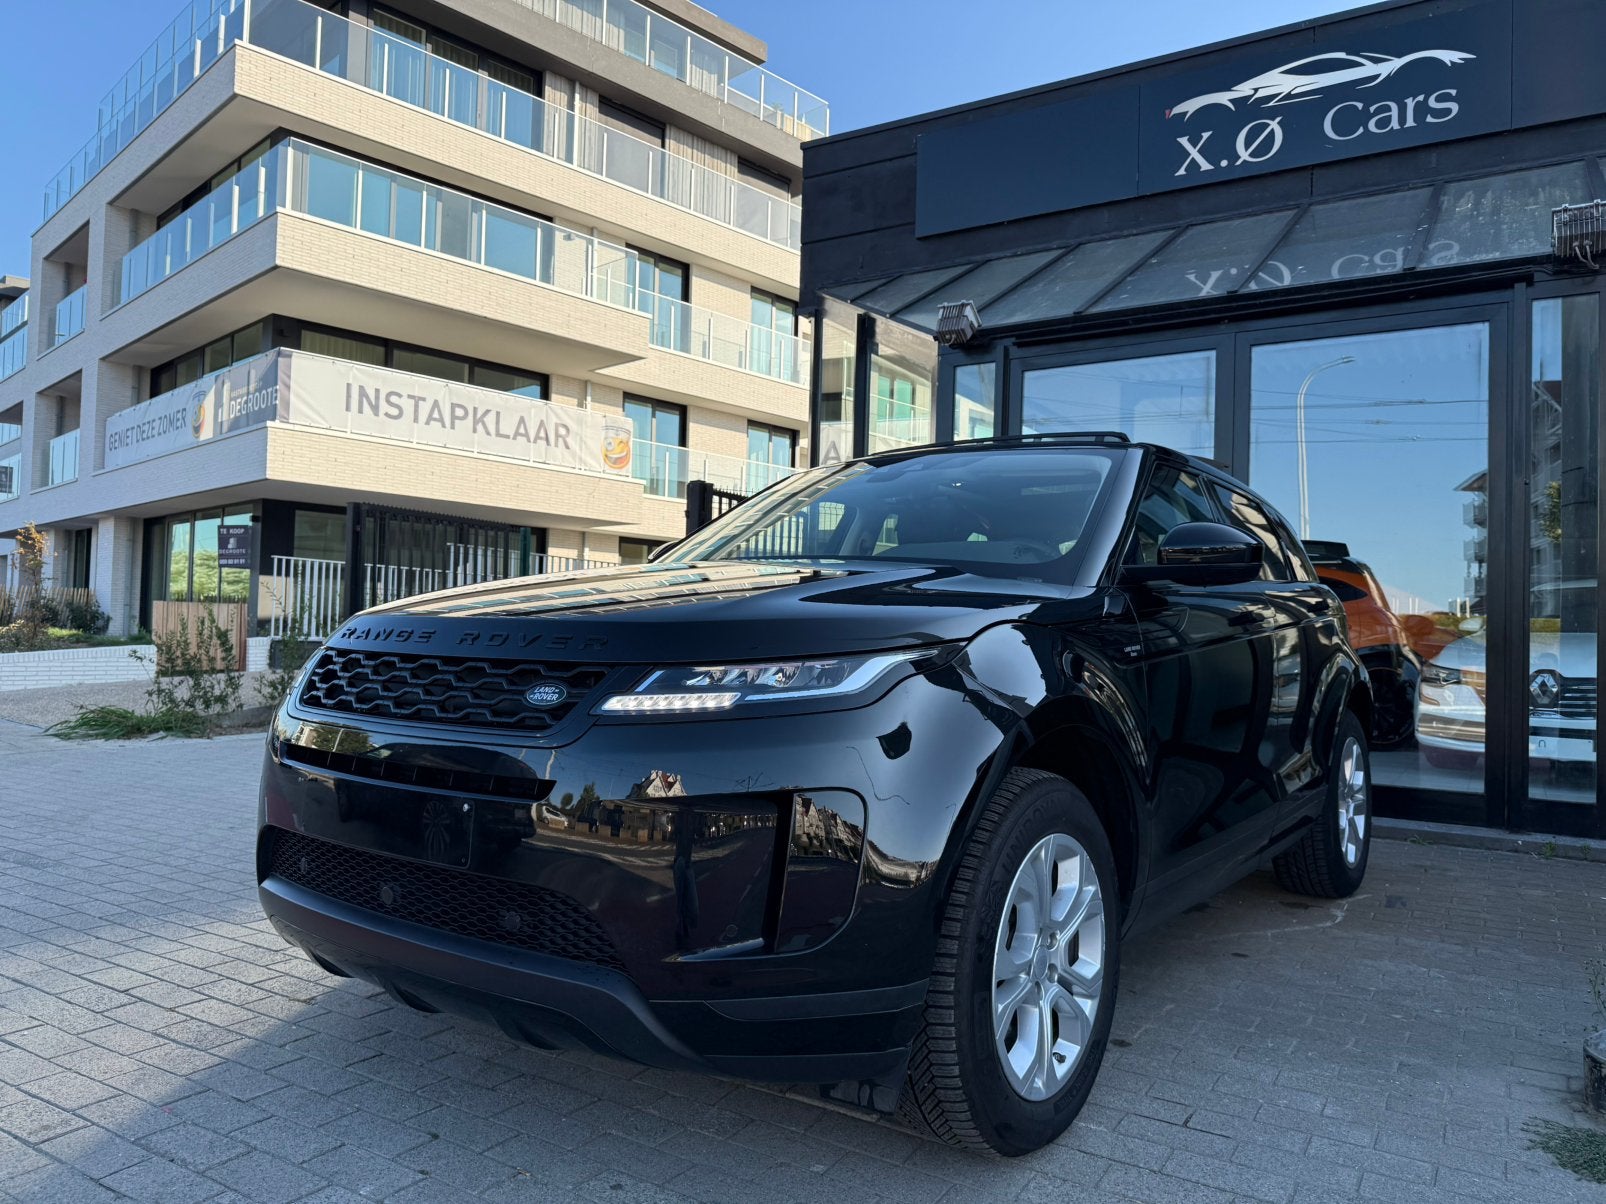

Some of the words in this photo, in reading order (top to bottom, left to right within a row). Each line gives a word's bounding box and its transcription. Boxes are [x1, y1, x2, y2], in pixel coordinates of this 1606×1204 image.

[1323, 89, 1459, 141] Cars
[230, 386, 279, 419] DEGROOTE
[345, 382, 571, 450] INSTAPKLAAR
[108, 426, 135, 452] GENIET
[135, 418, 156, 443] DEZE
[157, 407, 187, 437] ZOMER
[340, 626, 437, 644] RANGE
[456, 630, 609, 651] ROVER
